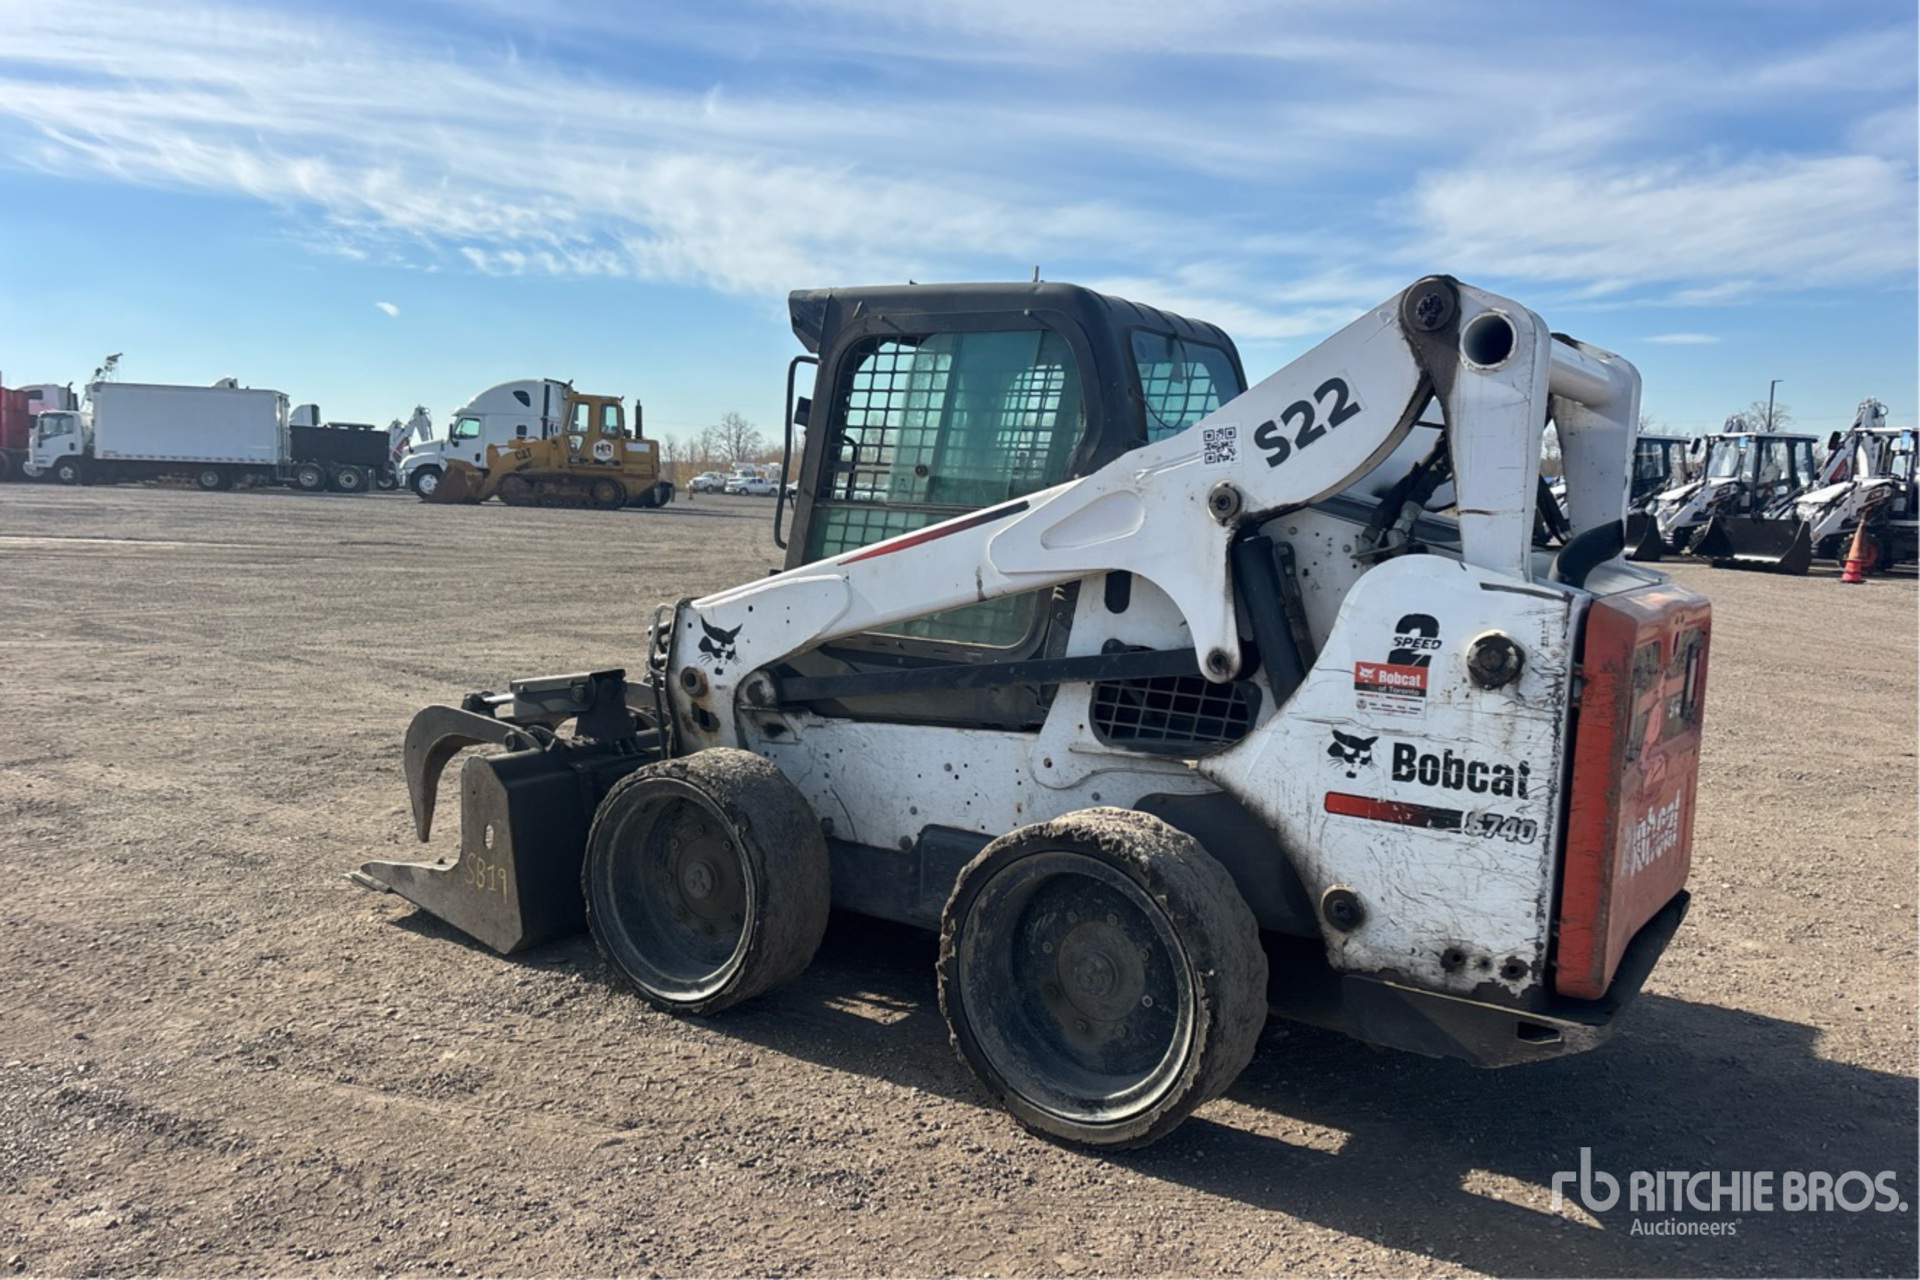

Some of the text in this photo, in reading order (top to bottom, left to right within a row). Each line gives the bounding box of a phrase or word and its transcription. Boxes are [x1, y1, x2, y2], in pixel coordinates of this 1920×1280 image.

[1254, 377, 1361, 468] S22
[515, 447, 532, 460] CAT
[1387, 613, 1440, 667] 2
[1393, 636, 1443, 650] SPEED
[1379, 670, 1421, 687] Bobcat
[1389, 686, 1420, 696] Toronto
[1392, 742, 1531, 800] Bobcat
